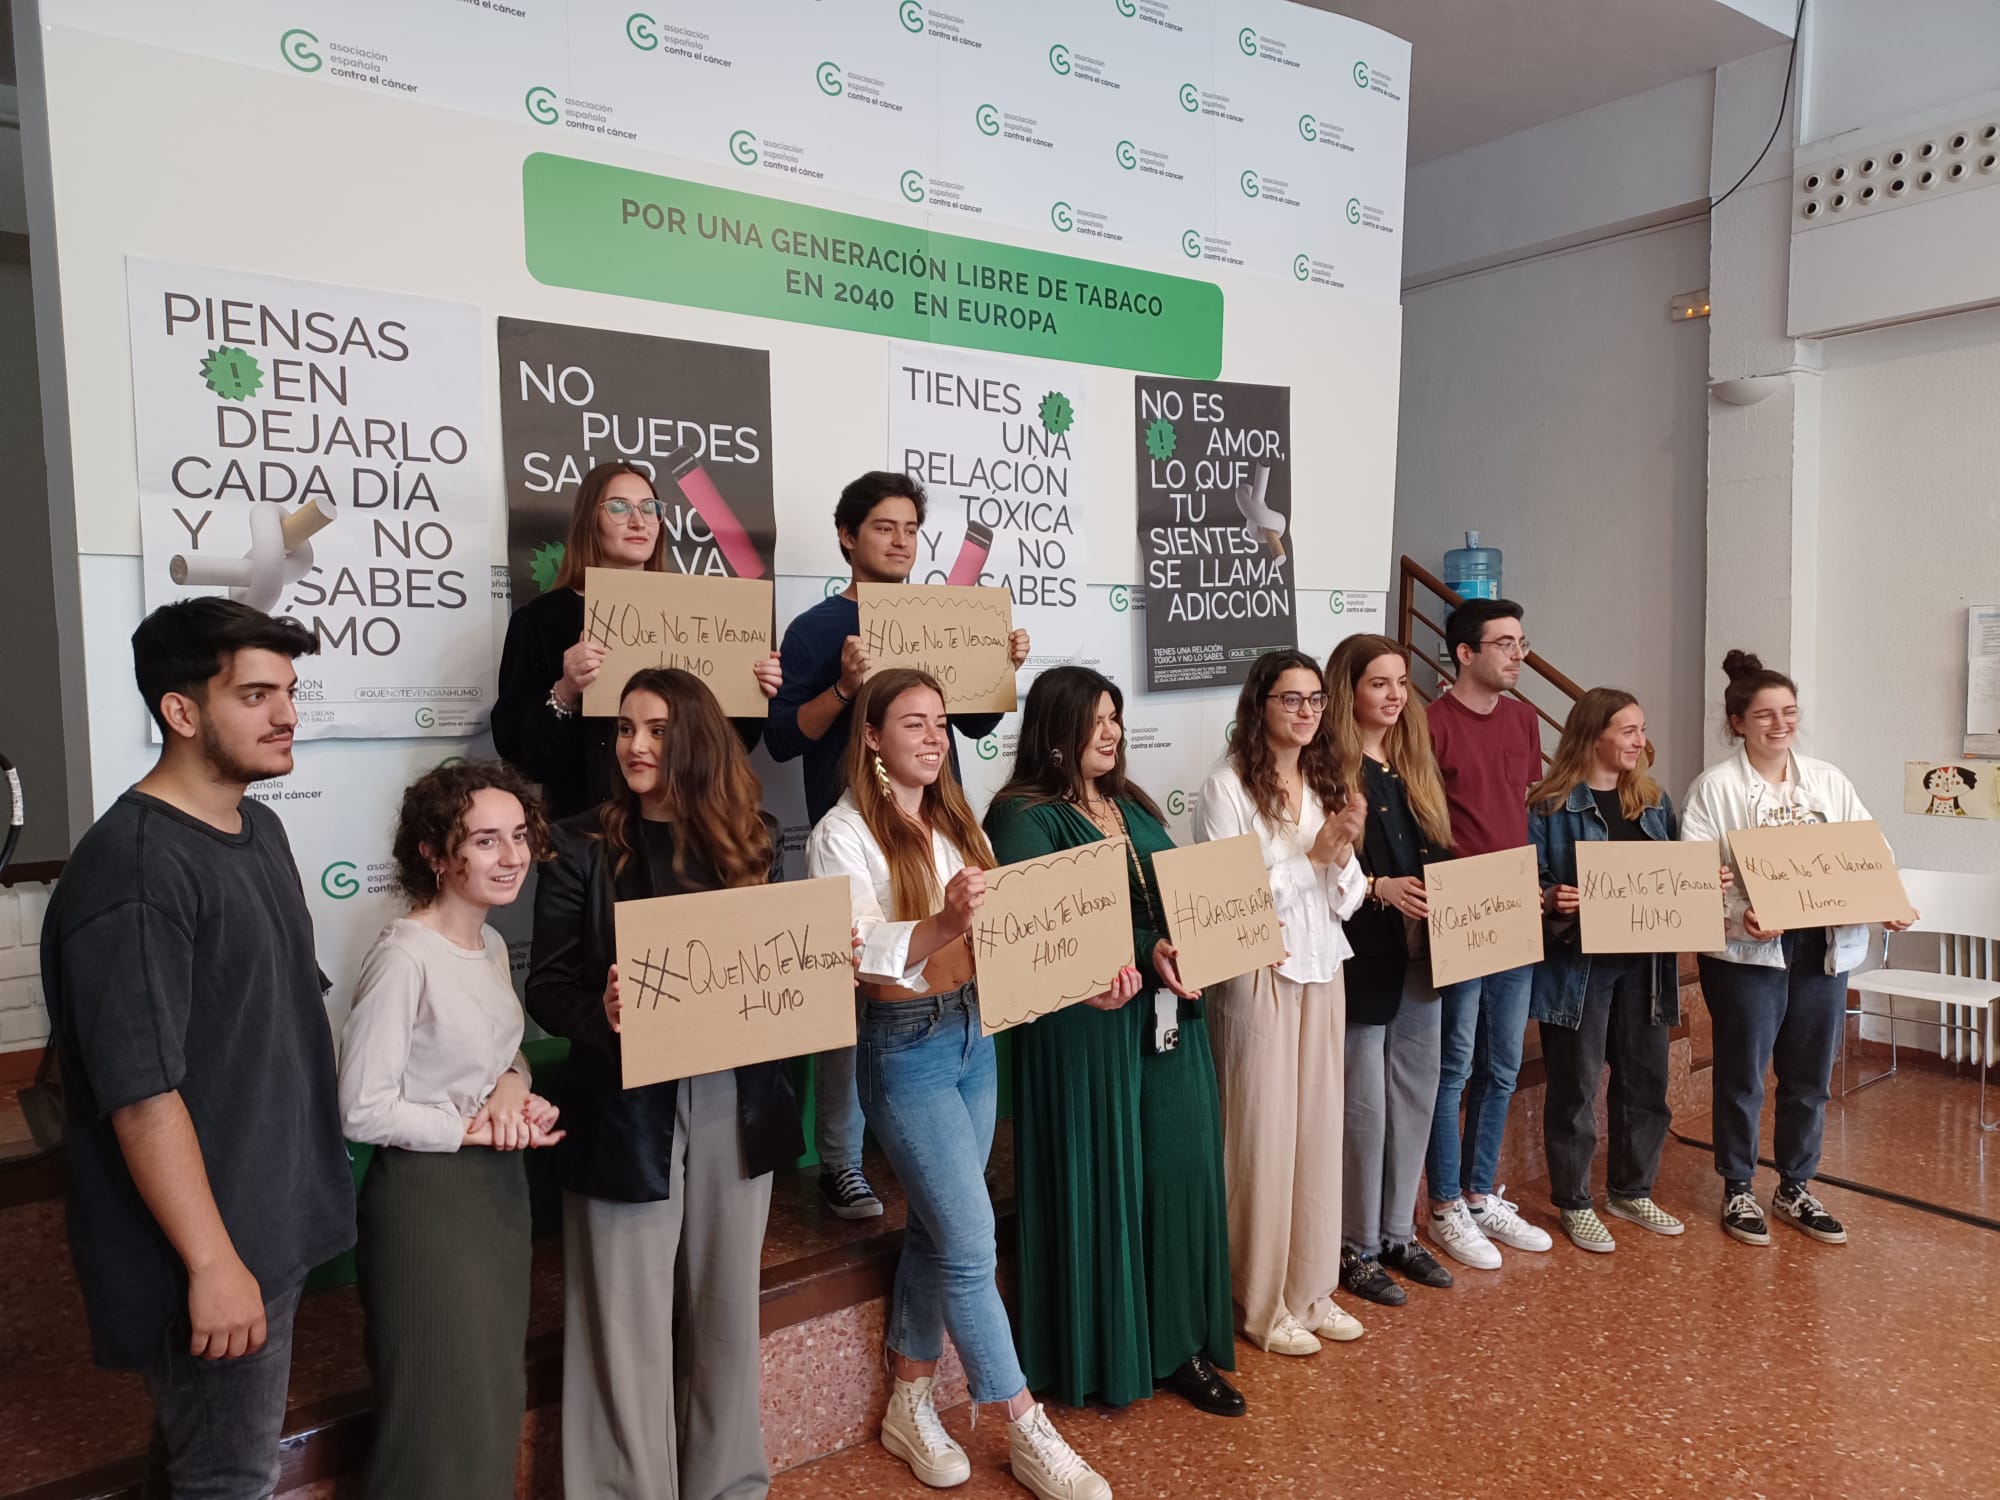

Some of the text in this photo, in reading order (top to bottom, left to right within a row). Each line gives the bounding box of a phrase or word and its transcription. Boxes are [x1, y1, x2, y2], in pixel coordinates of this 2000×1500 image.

[493, 3, 526, 18] cáncer
[664, 23, 709, 41] asociación
[664, 34, 703, 51] española
[928, 29, 950, 40] contra
[952, 34, 958, 42] el
[329, 42, 388, 62] asociación
[330, 54, 381, 73] española
[664, 45, 732, 68] contra el cáncer
[331, 67, 418, 93] contra el cáncer
[564, 97, 613, 113] asociación
[847, 91, 871, 103] contra
[871, 97, 878, 105] el
[565, 108, 607, 123] española
[565, 119, 637, 140] contra el cáncer
[763, 160, 824, 179] contra el cáncer
[928, 197, 951, 208] contra
[952, 201, 958, 209] el
[620, 197, 1163, 319] POR UNA GENERACIÓN LIBRE DE TABACO
[785, 269, 1057, 335] EN 2040 EN EUROPA
[164, 291, 410, 362] PIENSAS
[272, 358, 348, 406] EN
[519, 360, 595, 406] NO
[902, 366, 1022, 415] TIENES
[1141, 389, 1225, 423] NO ES
[216, 404, 468, 465] DEJARLO
[582, 411, 760, 464] PUEDES
[1003, 422, 1072, 461] UNA
[1206, 427, 1286, 462] AMOR,
[171, 455, 440, 513] CADA DÍA
[904, 448, 1068, 498] RELACIÓN
[1151, 459, 1186, 489] LO
[959, 489, 1074, 535] TÓXICA
[1169, 487, 1206, 522] TÚ
[172, 508, 453, 560] Y NO
[920, 530, 1066, 570] Y NO
[1150, 527, 1258, 556] SIENTES
[672, 546, 729, 578] VA
[1149, 558, 1284, 589] SE LLAMA
[293, 565, 468, 609] SABES
[1168, 584, 1290, 622] ADICCIÓN
[1153, 648, 1176, 656] TIENES
[1177, 646, 1191, 655] UNA
[1192, 644, 1223, 654] RELACIÓN
[272, 790, 282, 800] el
[284, 789, 322, 800] cáncer
